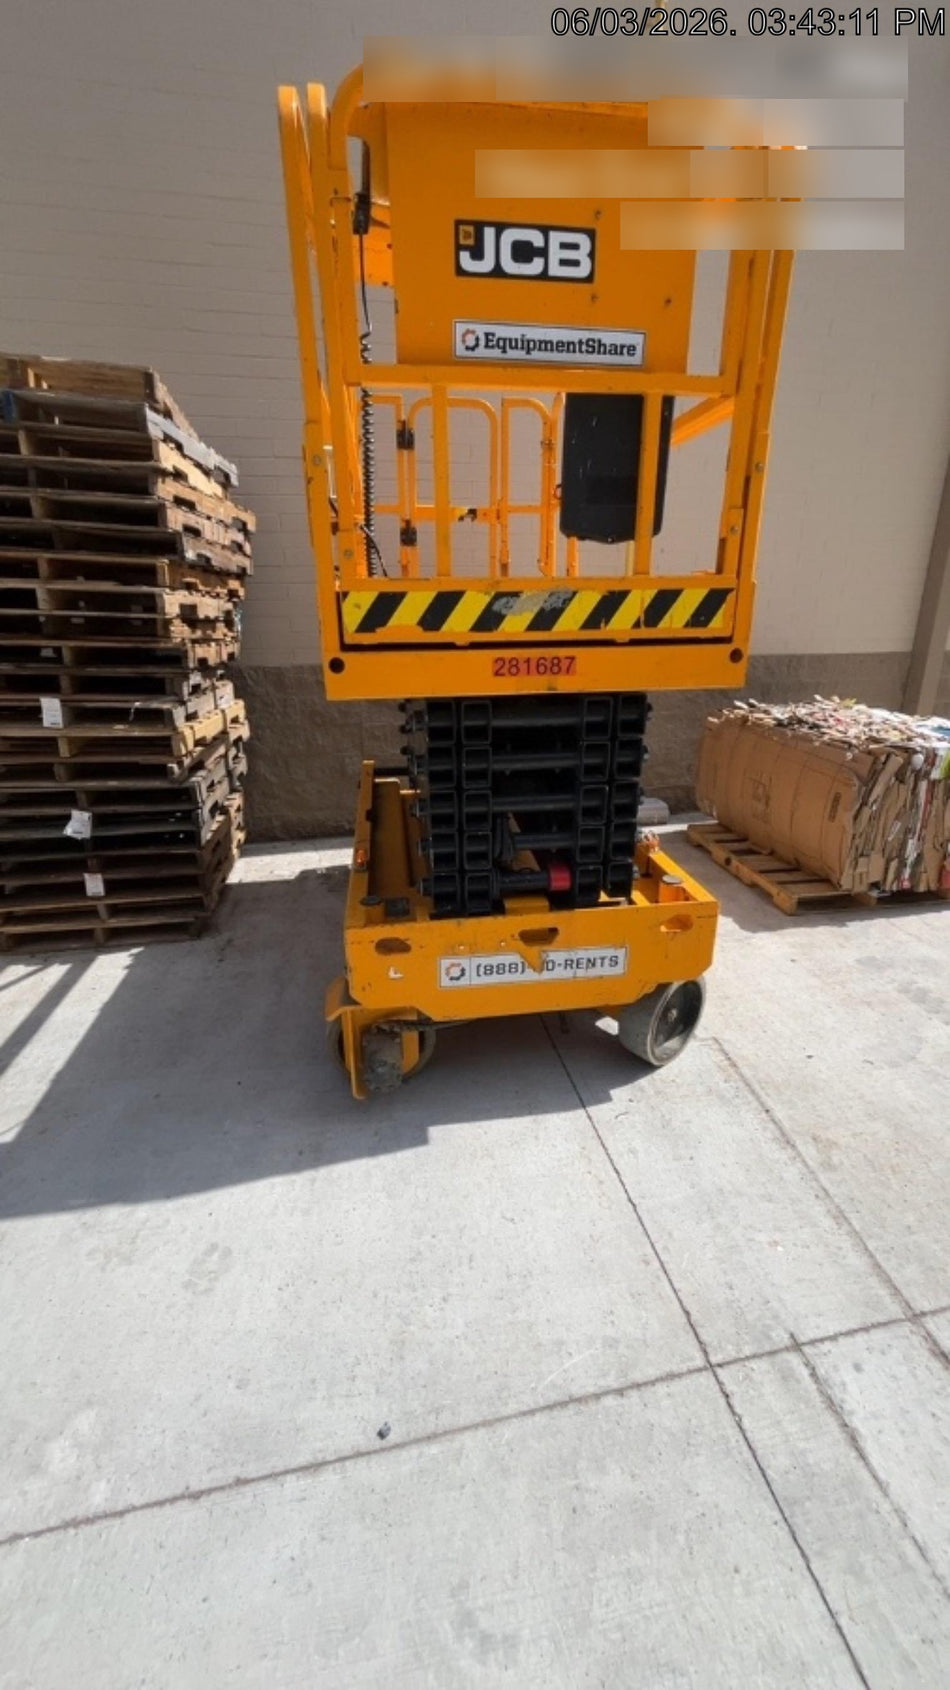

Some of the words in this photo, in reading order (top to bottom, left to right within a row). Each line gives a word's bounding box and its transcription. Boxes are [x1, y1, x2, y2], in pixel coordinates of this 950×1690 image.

[459, 226, 592, 279] JCB
[483, 331, 637, 357] EquipmentShare
[493, 655, 576, 677] 281687
